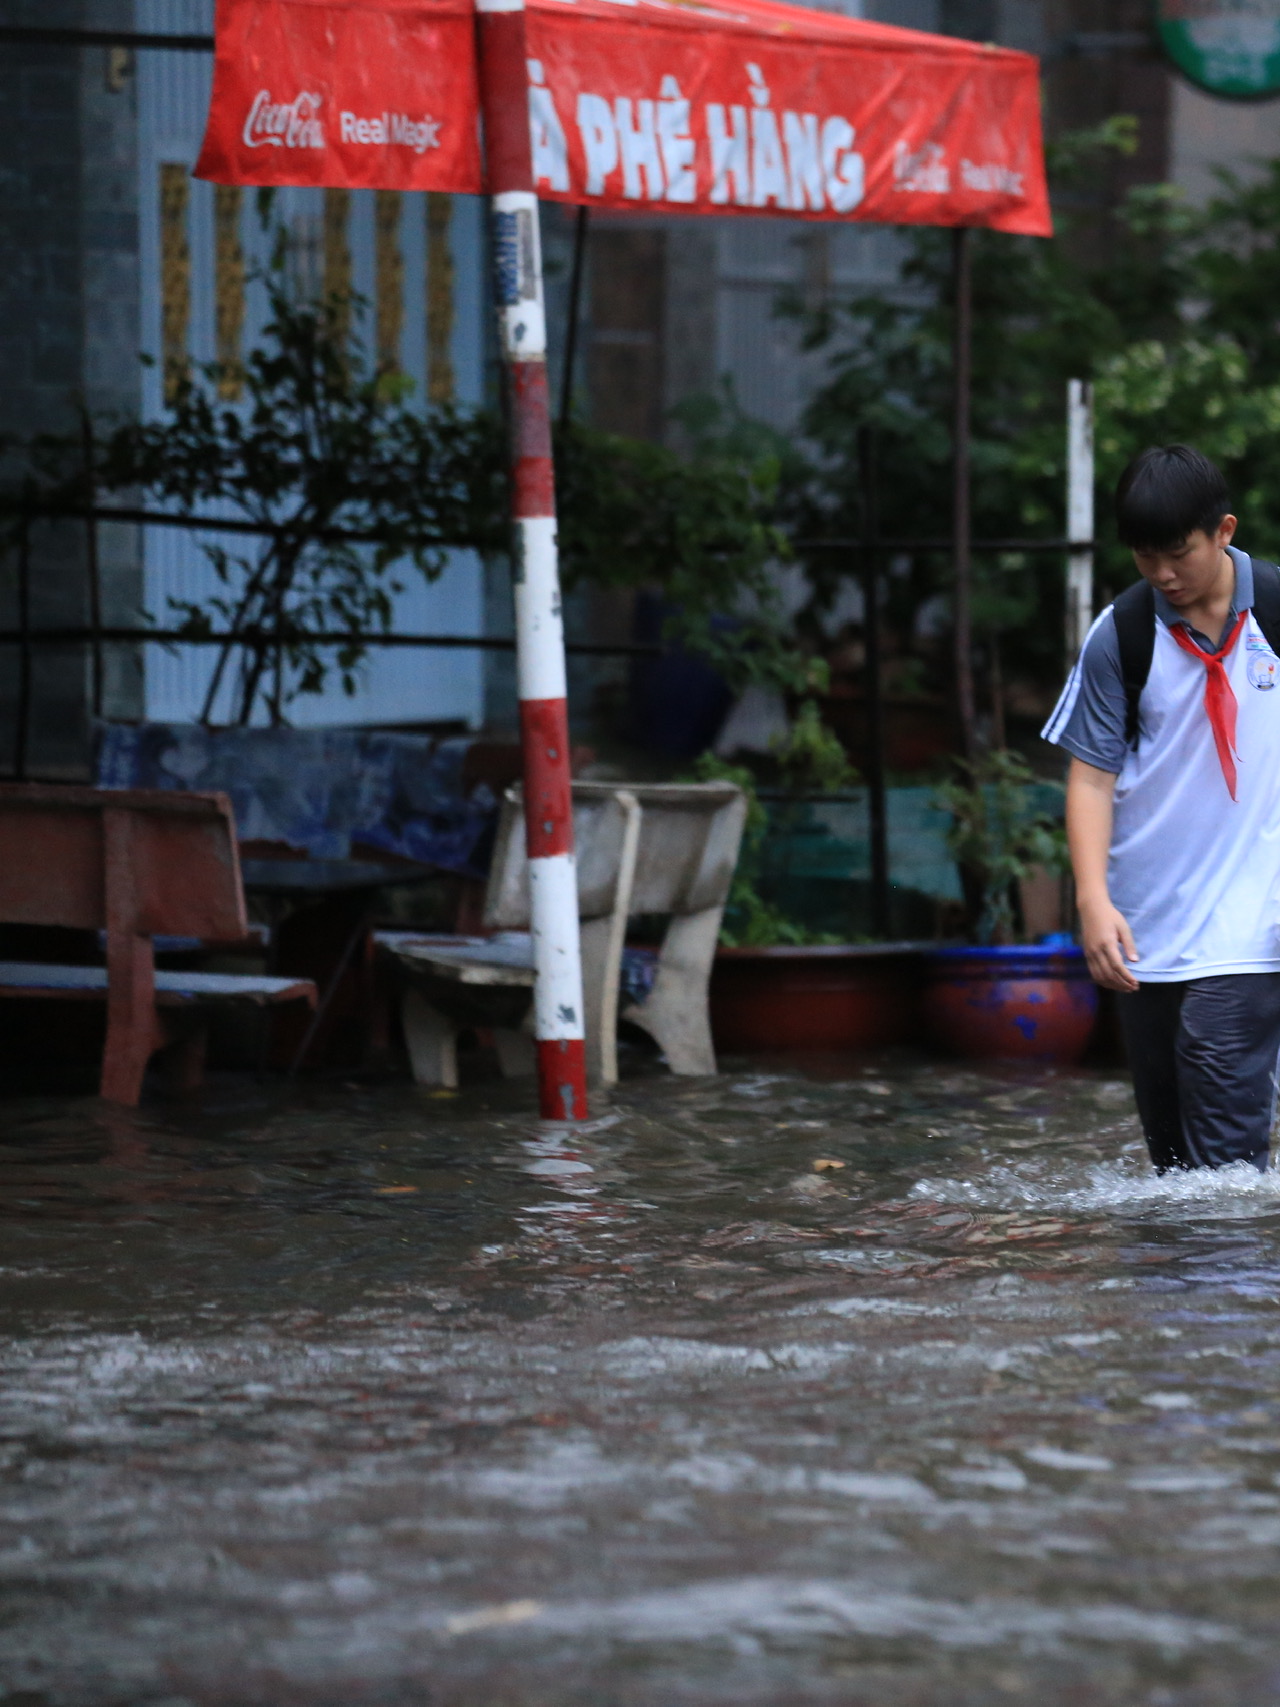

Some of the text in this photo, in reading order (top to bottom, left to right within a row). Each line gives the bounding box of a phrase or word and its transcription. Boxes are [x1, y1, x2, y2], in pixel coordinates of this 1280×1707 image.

[340, 112, 442, 154] Real Magic
[526, 58, 570, 192] À
[576, 75, 697, 203] PHÊ
